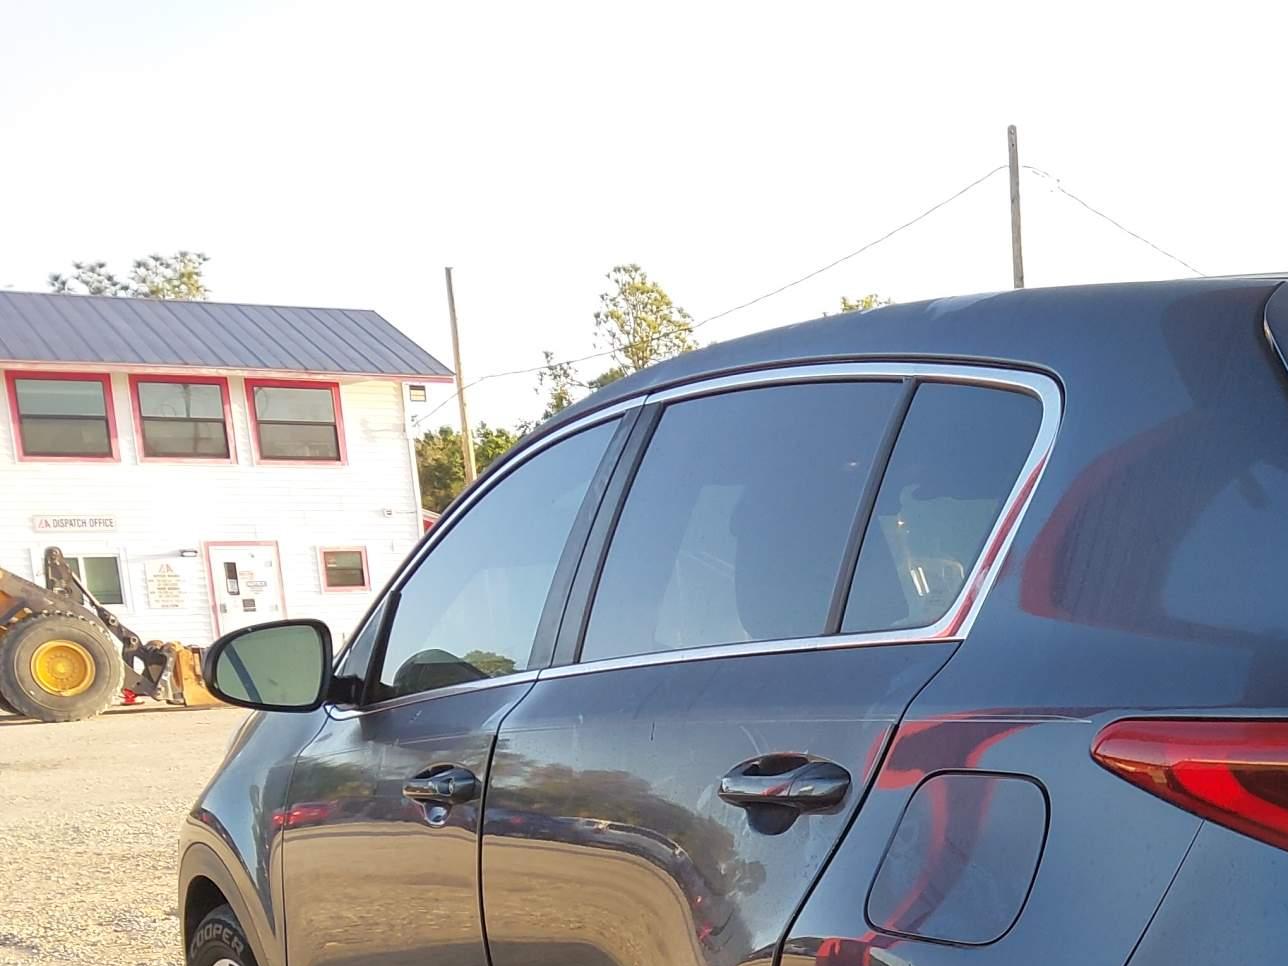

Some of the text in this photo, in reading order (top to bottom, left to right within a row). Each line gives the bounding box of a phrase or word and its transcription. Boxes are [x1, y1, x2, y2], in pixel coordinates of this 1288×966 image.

[53, 518, 87, 528] DISPATCH
[89, 518, 114, 528] OFFICE
[190, 922, 244, 958] COOPER
